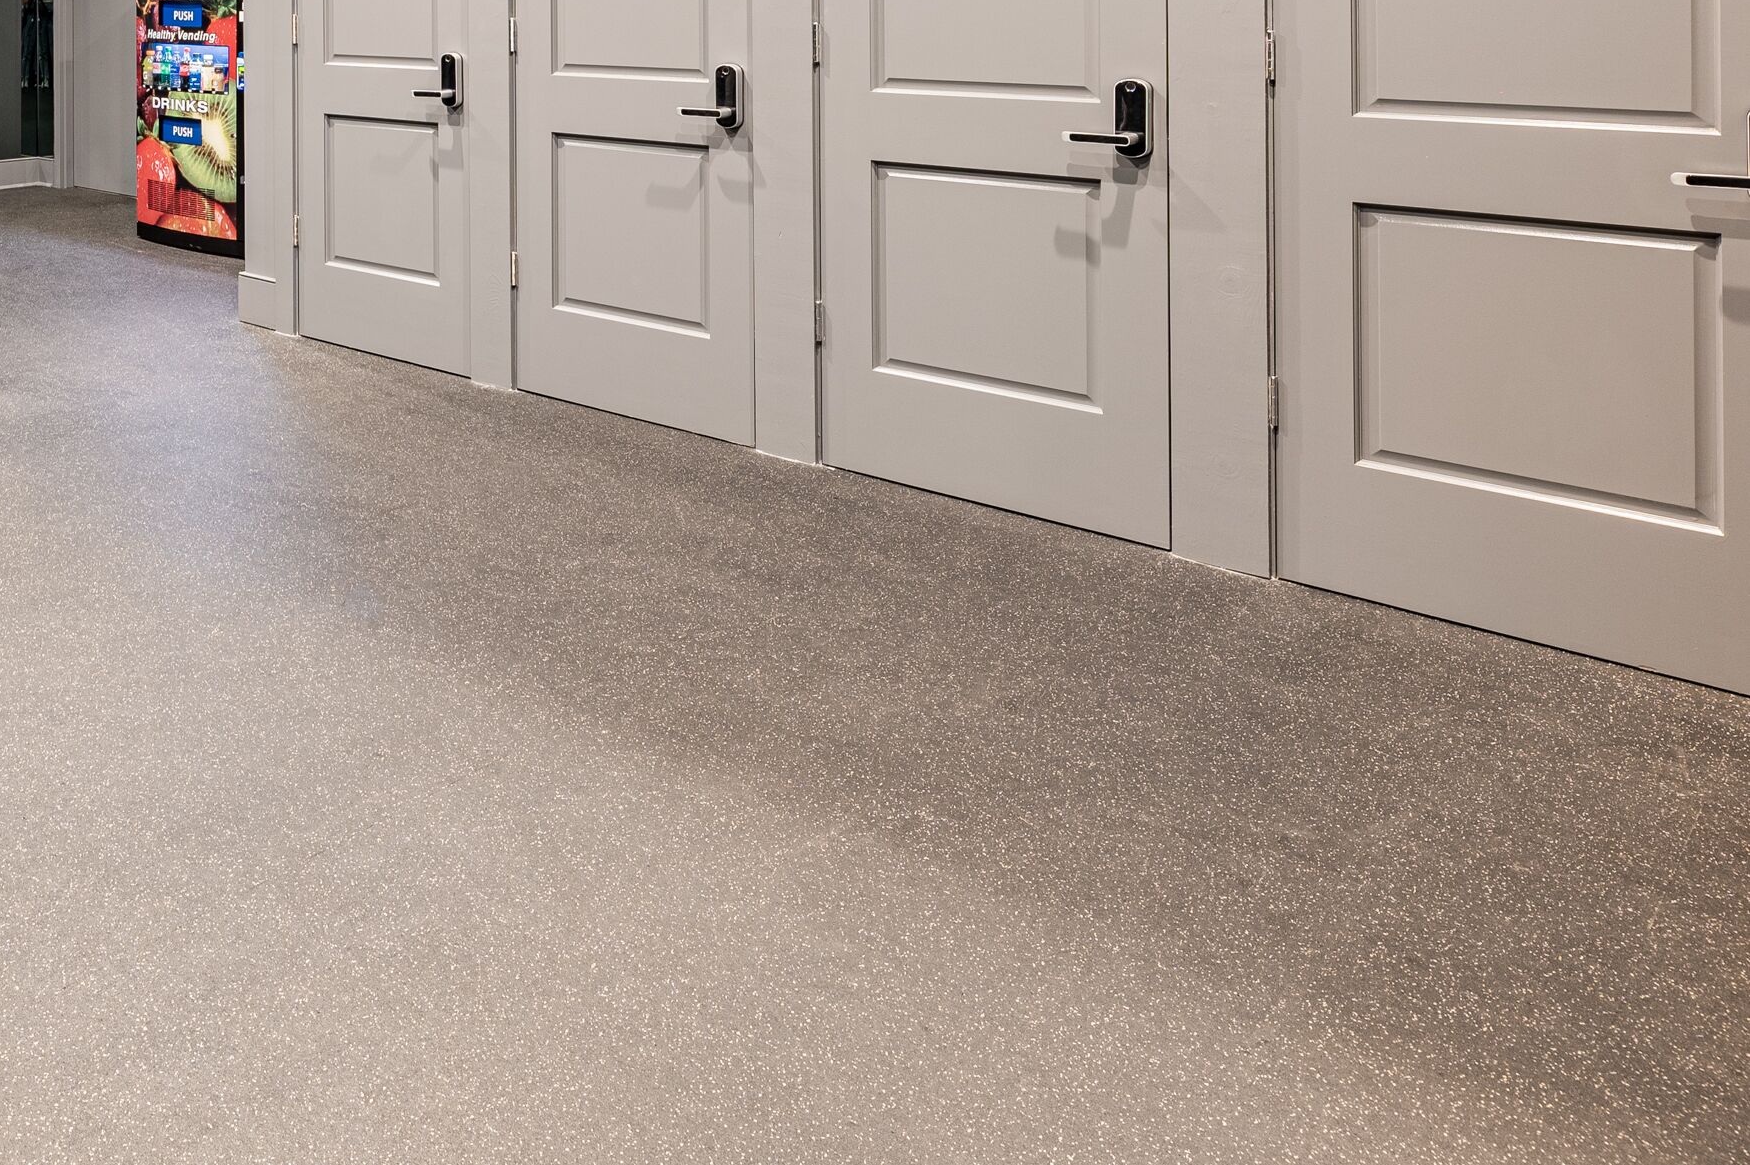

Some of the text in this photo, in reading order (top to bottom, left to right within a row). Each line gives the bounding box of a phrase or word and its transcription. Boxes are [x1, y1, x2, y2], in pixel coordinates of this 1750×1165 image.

[173, 10, 194, 22] PUSH
[147, 28, 217, 44] Healthy Vending
[152, 96, 209, 114] DRINKS
[172, 125, 193, 138] PUSH
